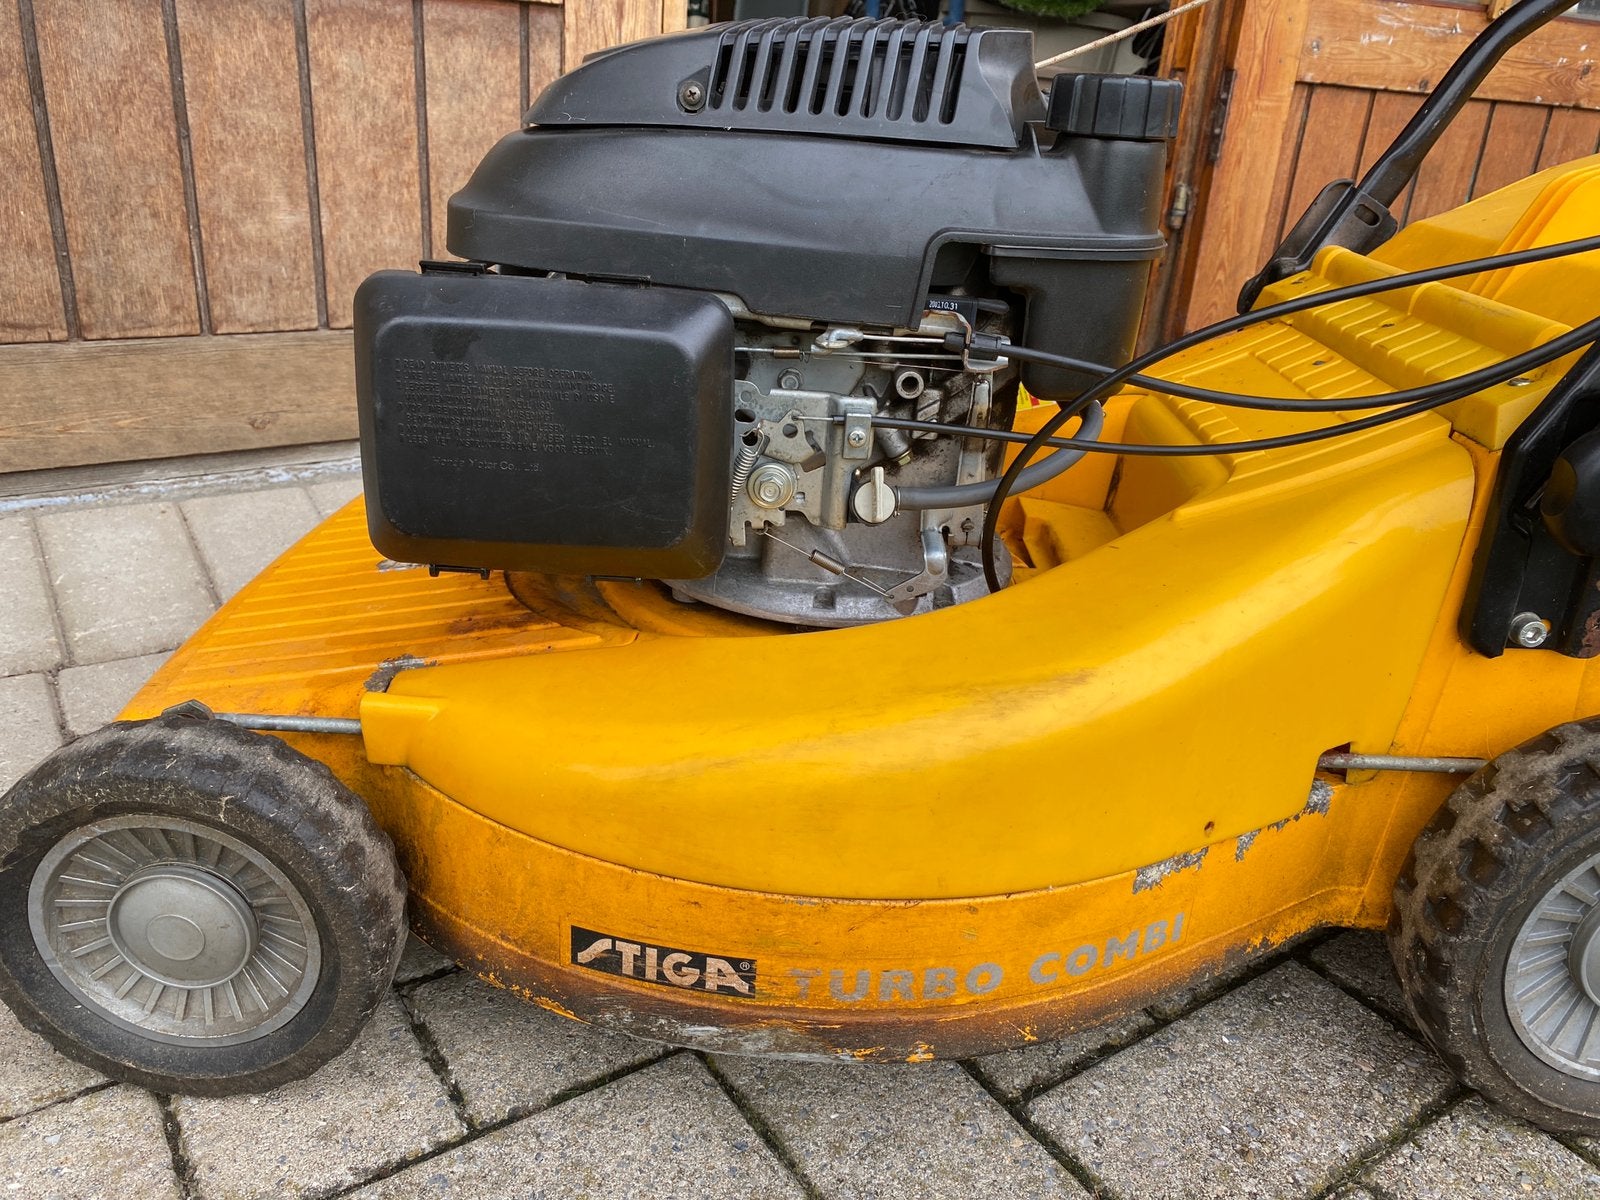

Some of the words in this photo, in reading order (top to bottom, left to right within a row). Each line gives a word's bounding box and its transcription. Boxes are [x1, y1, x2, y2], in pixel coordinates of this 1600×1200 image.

[403, 358, 426, 370] READ
[513, 366, 545, 377] BEFORE
[577, 938, 752, 993] STIGA
[787, 962, 1003, 1002] TURBO
[1029, 912, 1184, 984] COMBI
